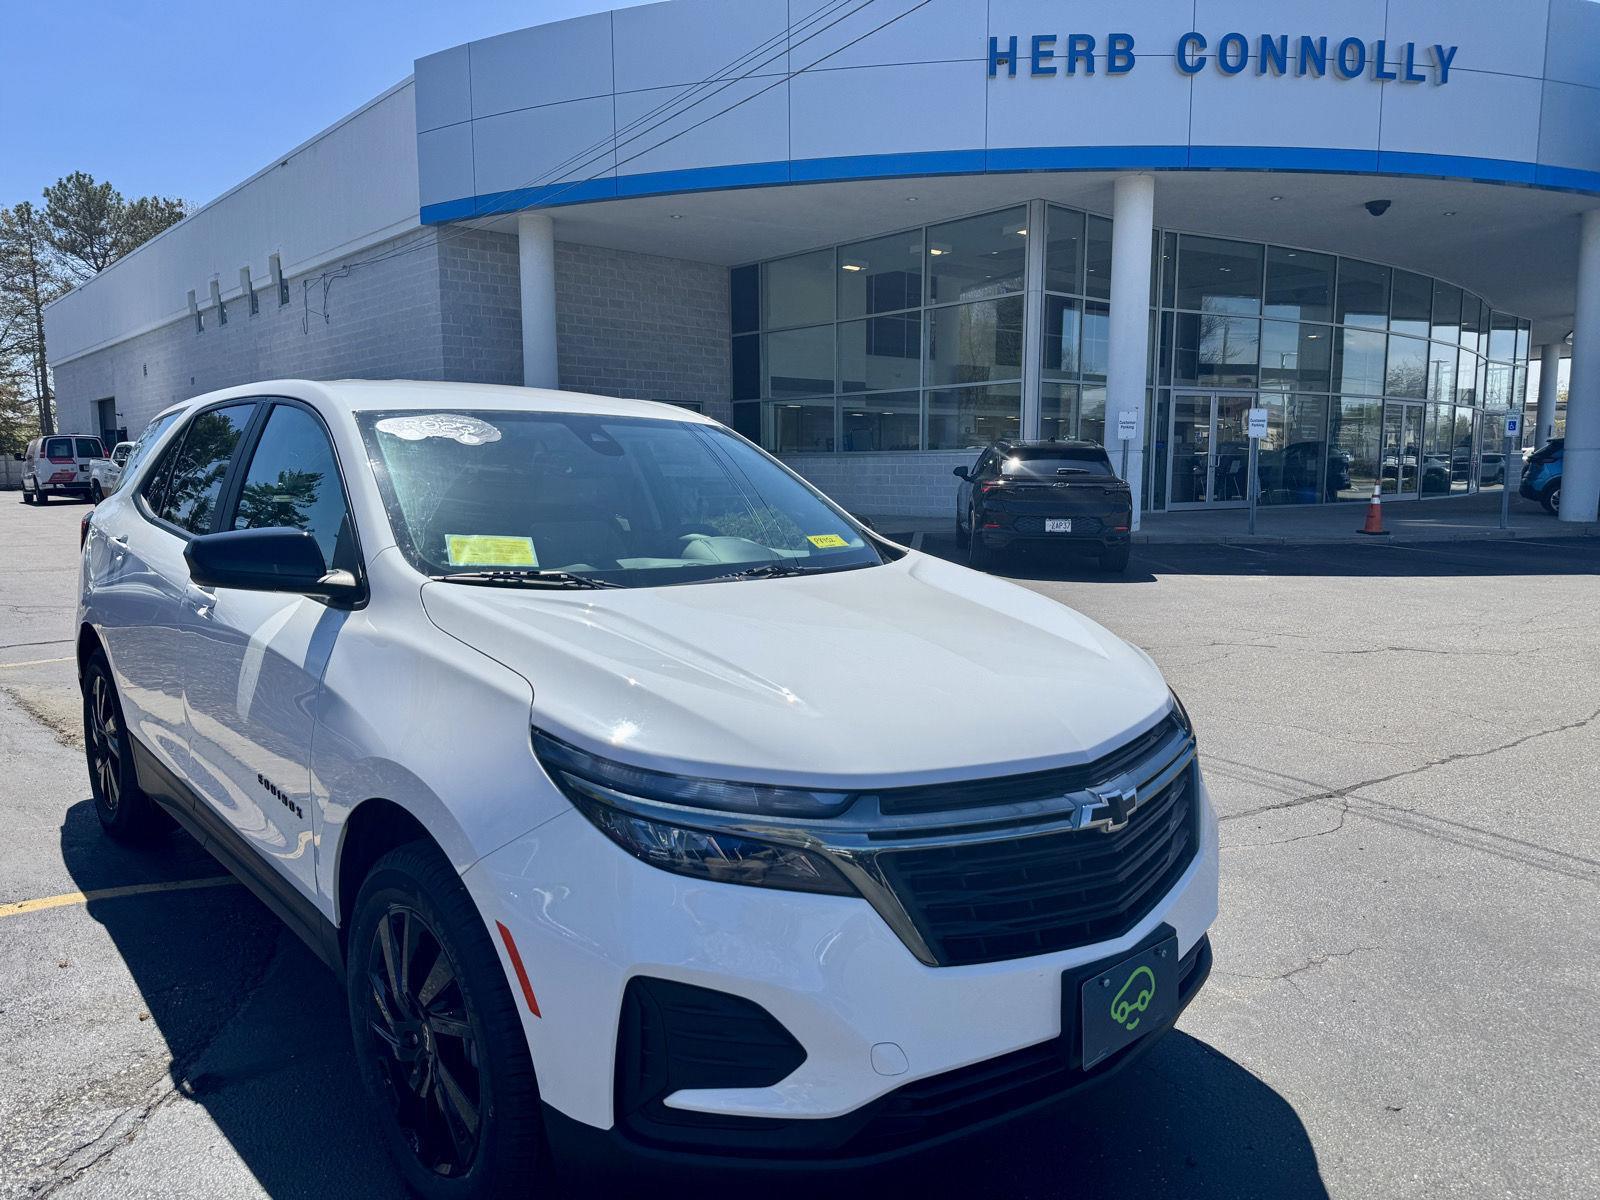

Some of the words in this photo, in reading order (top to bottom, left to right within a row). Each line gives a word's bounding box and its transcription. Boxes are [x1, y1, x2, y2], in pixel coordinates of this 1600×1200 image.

[988, 33, 1137, 79] HERB
[1175, 31, 1458, 86] CONNOLLY
[258, 774, 303, 819] EQUINOX
